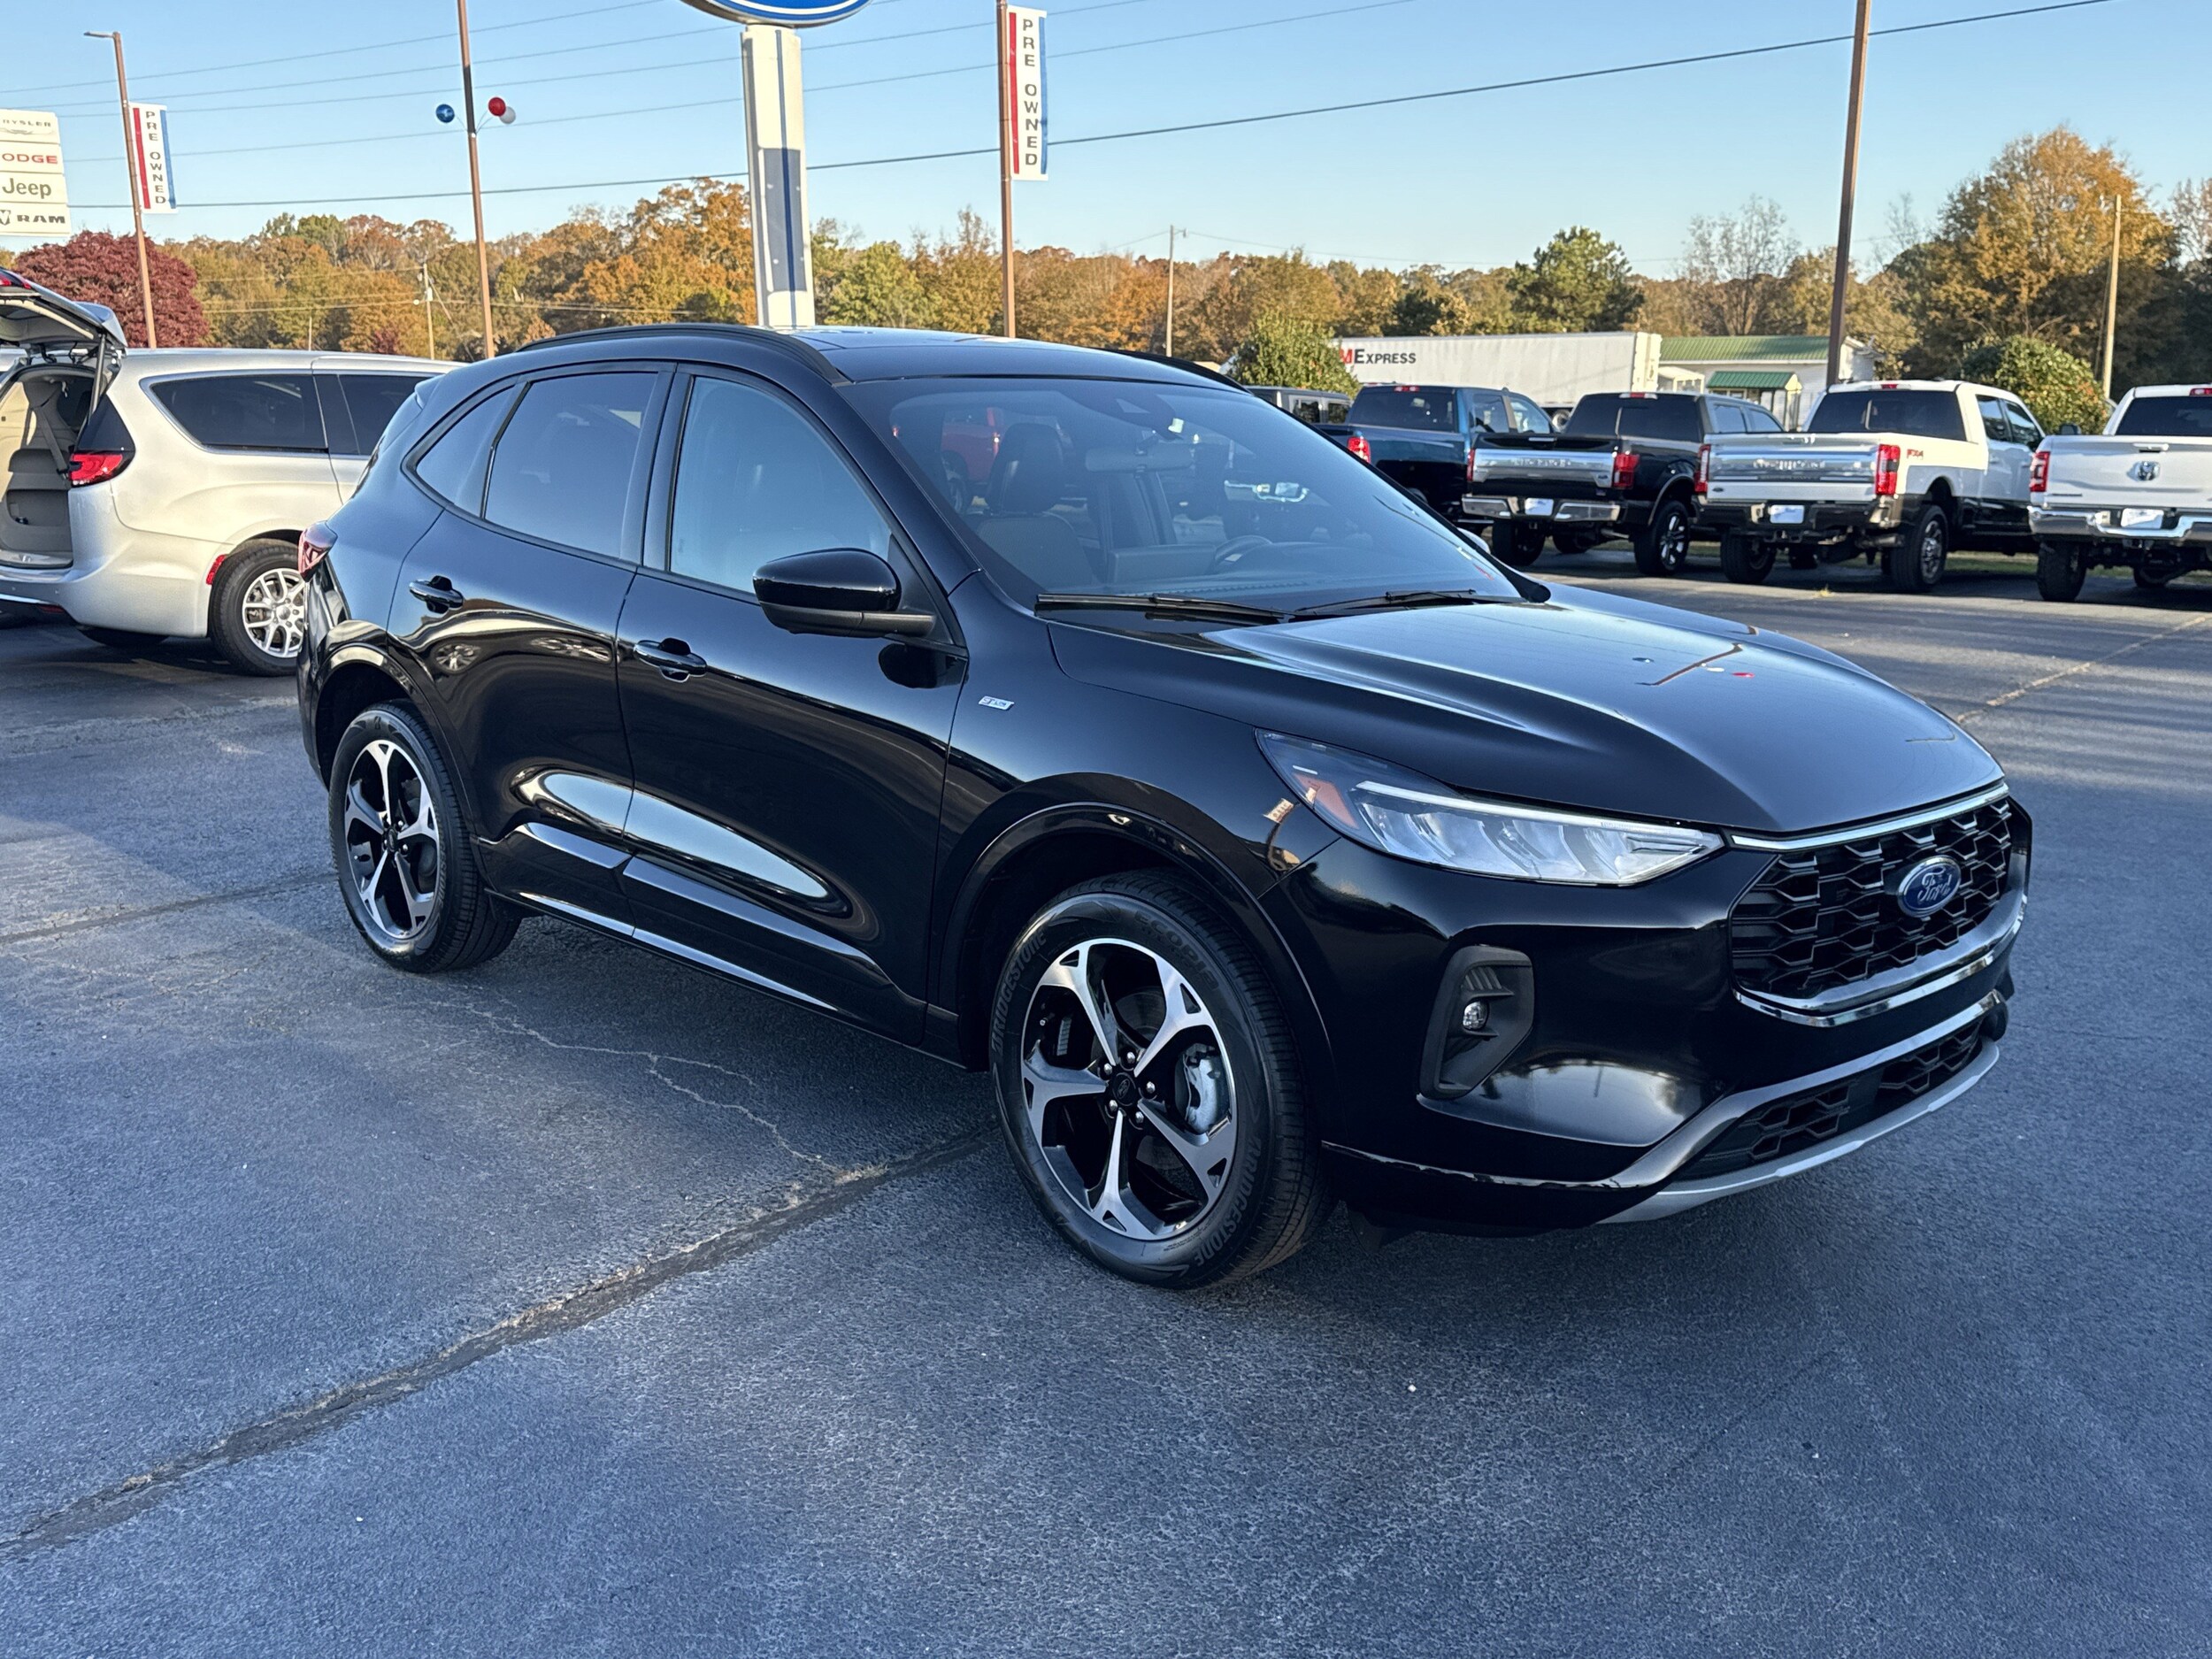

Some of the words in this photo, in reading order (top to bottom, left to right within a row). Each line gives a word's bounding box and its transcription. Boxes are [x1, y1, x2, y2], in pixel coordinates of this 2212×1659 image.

[1022, 18, 1035, 67] PRE
[145, 111, 158, 142] PRE
[1023, 83, 1039, 166] OWNED
[2, 178, 52, 199] Jeep
[150, 151, 166, 204] OWNED
[17, 214, 66, 224] RAM
